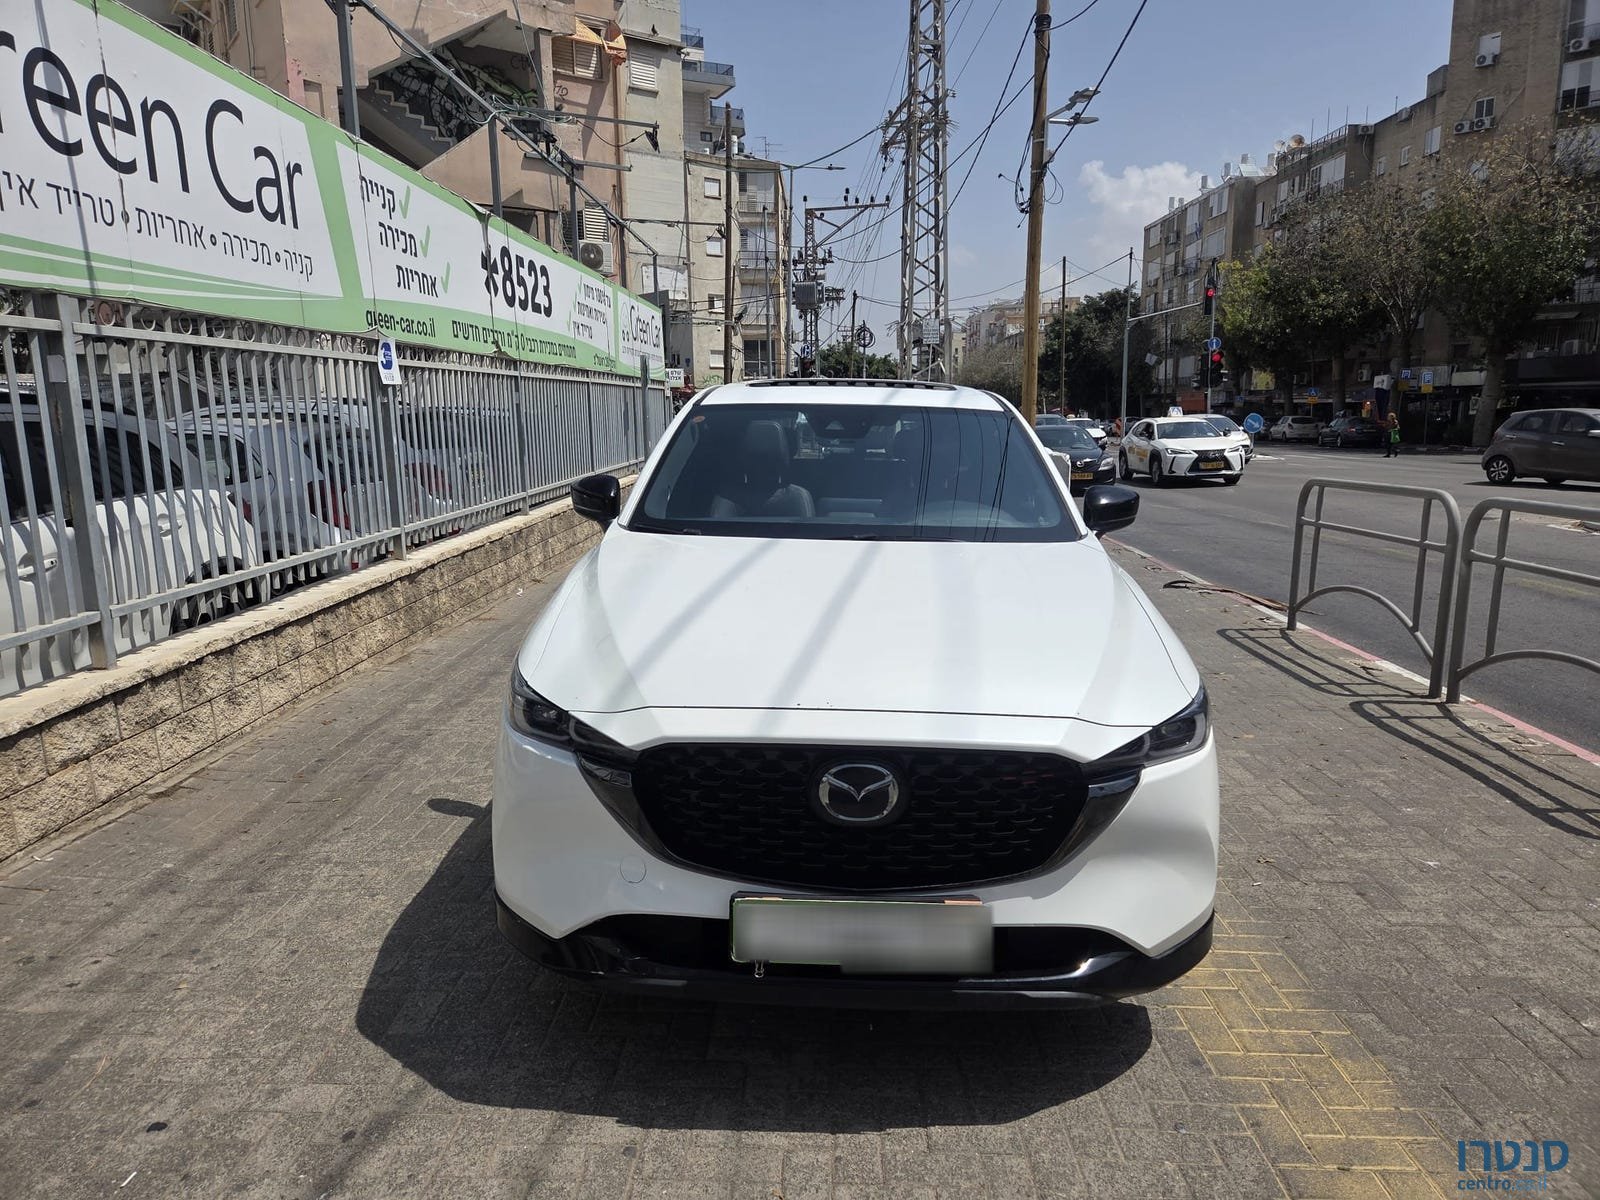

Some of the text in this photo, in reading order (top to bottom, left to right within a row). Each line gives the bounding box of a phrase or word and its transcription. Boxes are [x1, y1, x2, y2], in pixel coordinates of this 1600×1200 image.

[205, 99, 303, 230] Car
[135, 207, 207, 250] אחריות
[378, 221, 418, 258] מכירה
[221, 231, 272, 266] מכירה
[284, 249, 313, 282] קניה
[396, 264, 438, 298] אחריות
[366, 310, 436, 338] green-car.co.il
[451, 320, 481, 342] חדשים
